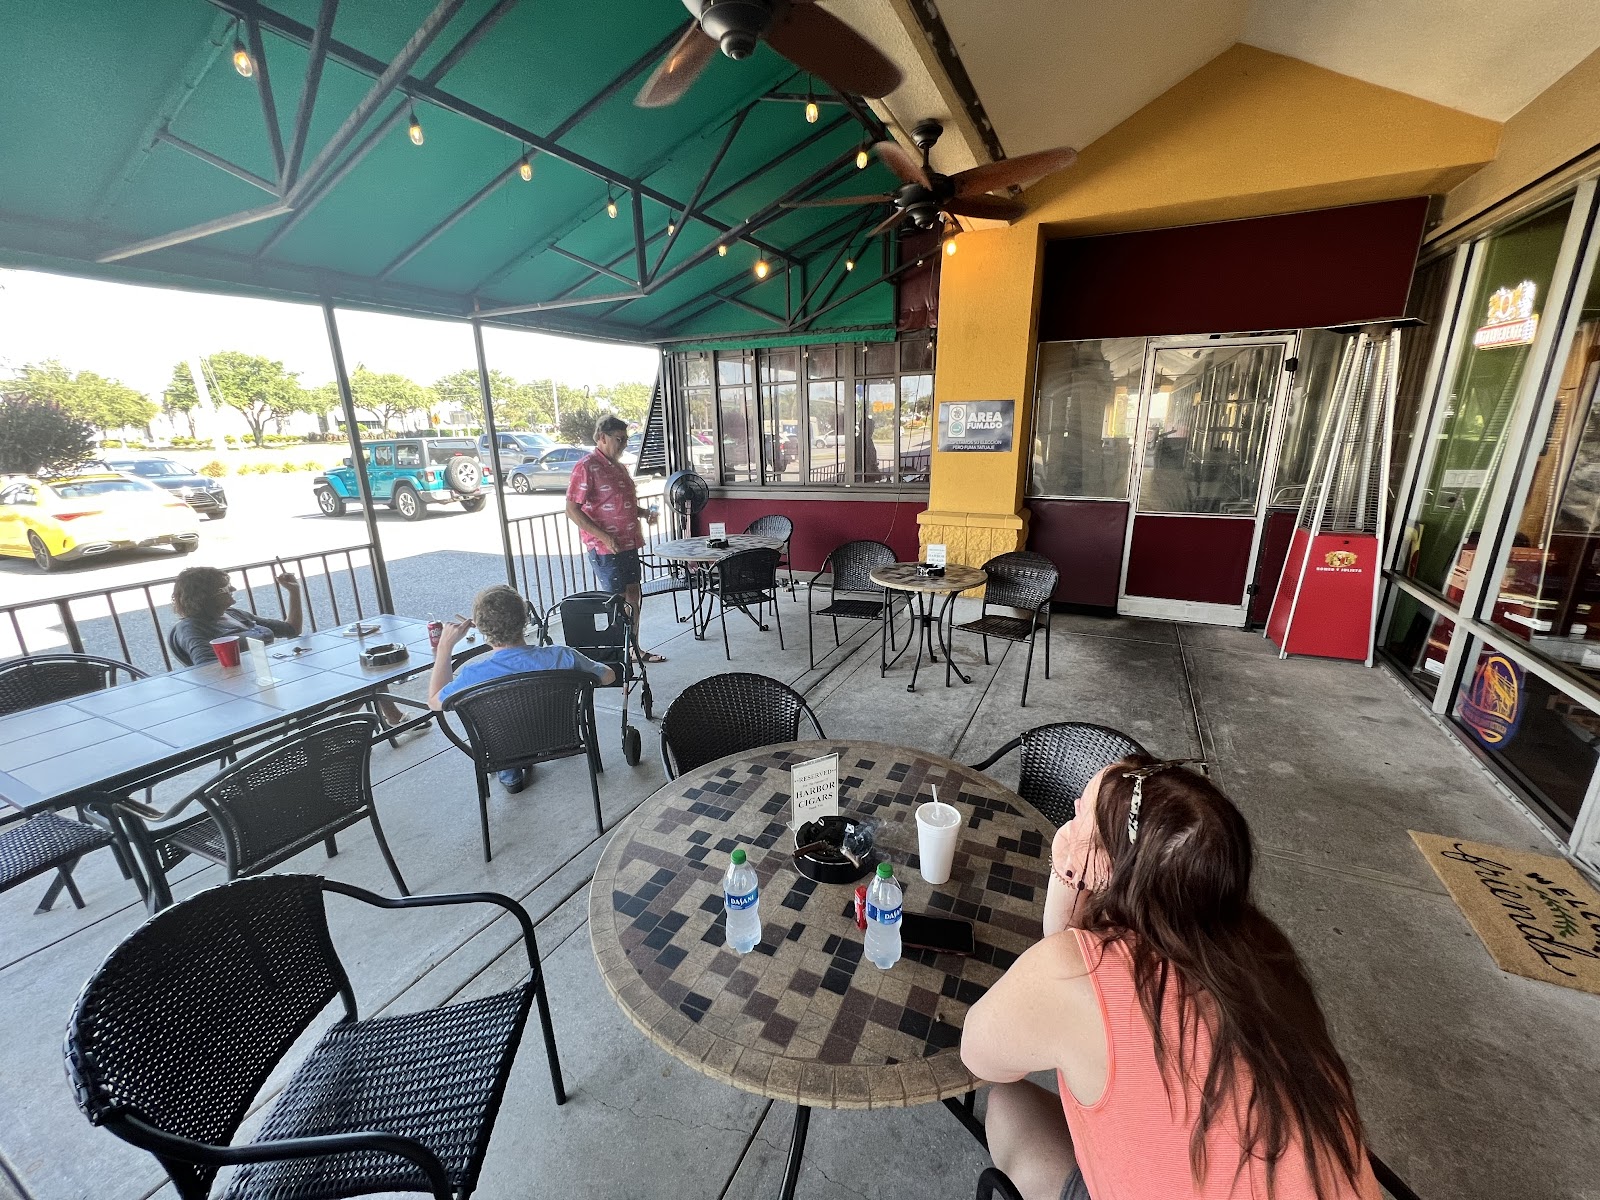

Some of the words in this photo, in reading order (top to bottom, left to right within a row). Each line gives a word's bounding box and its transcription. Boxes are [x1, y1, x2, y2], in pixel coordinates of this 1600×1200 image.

[967, 411, 1003, 422] AREA
[966, 422, 1003, 430] FUMADO
[799, 769, 832, 781] RESERVED
[796, 782, 835, 798] HARBOR
[798, 792, 833, 808] CIGARS
[730, 894, 754, 906] DASANI
